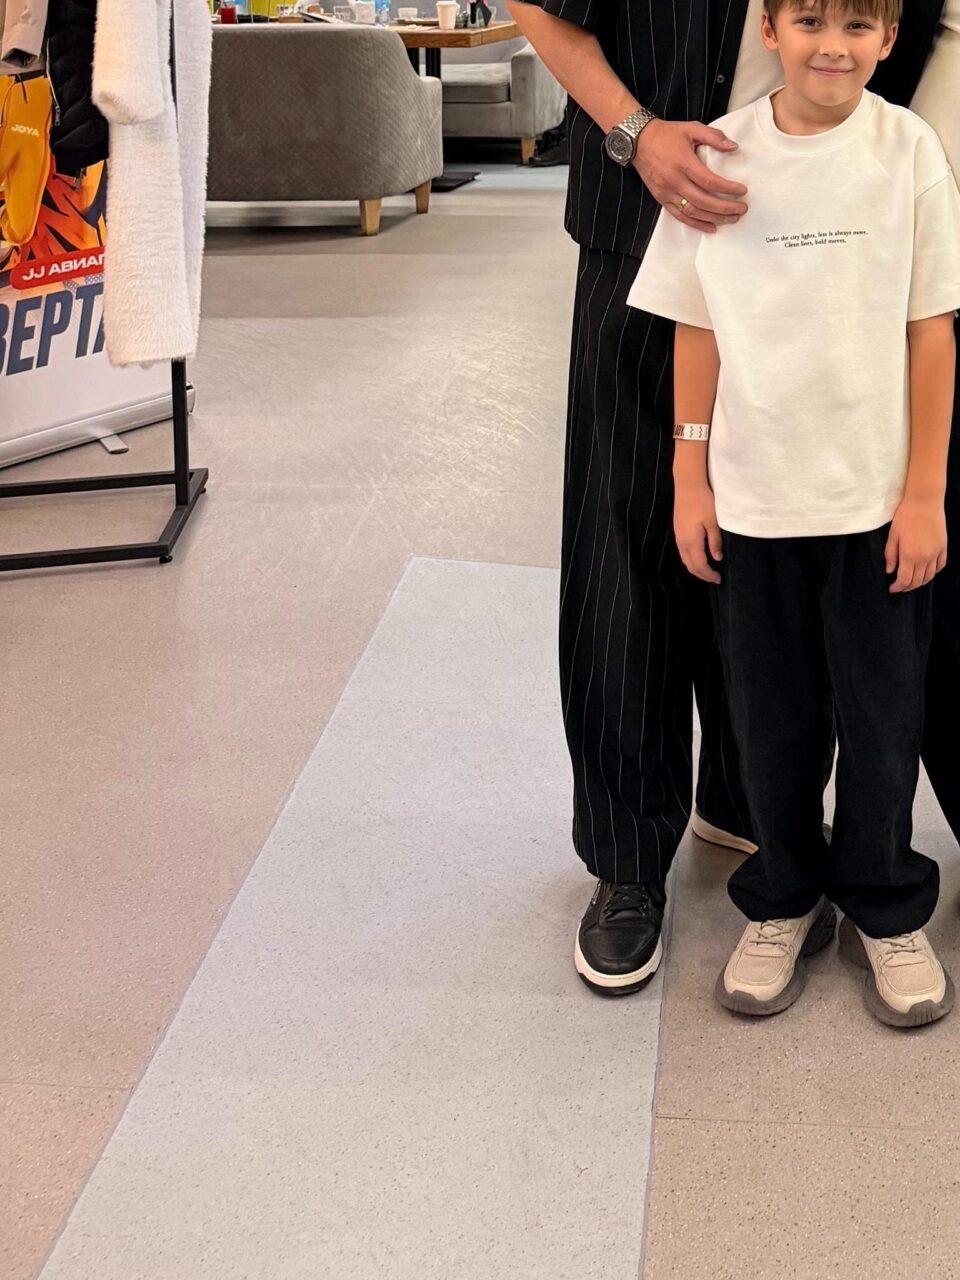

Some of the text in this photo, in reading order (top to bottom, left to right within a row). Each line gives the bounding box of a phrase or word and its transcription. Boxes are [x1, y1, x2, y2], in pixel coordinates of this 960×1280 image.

[11, 124, 40, 137] JOYA
[790, 233, 800, 241] city
[801, 232, 817, 241] lights,
[834, 230, 852, 238] always
[0, 282, 105, 377] ЕРТ
